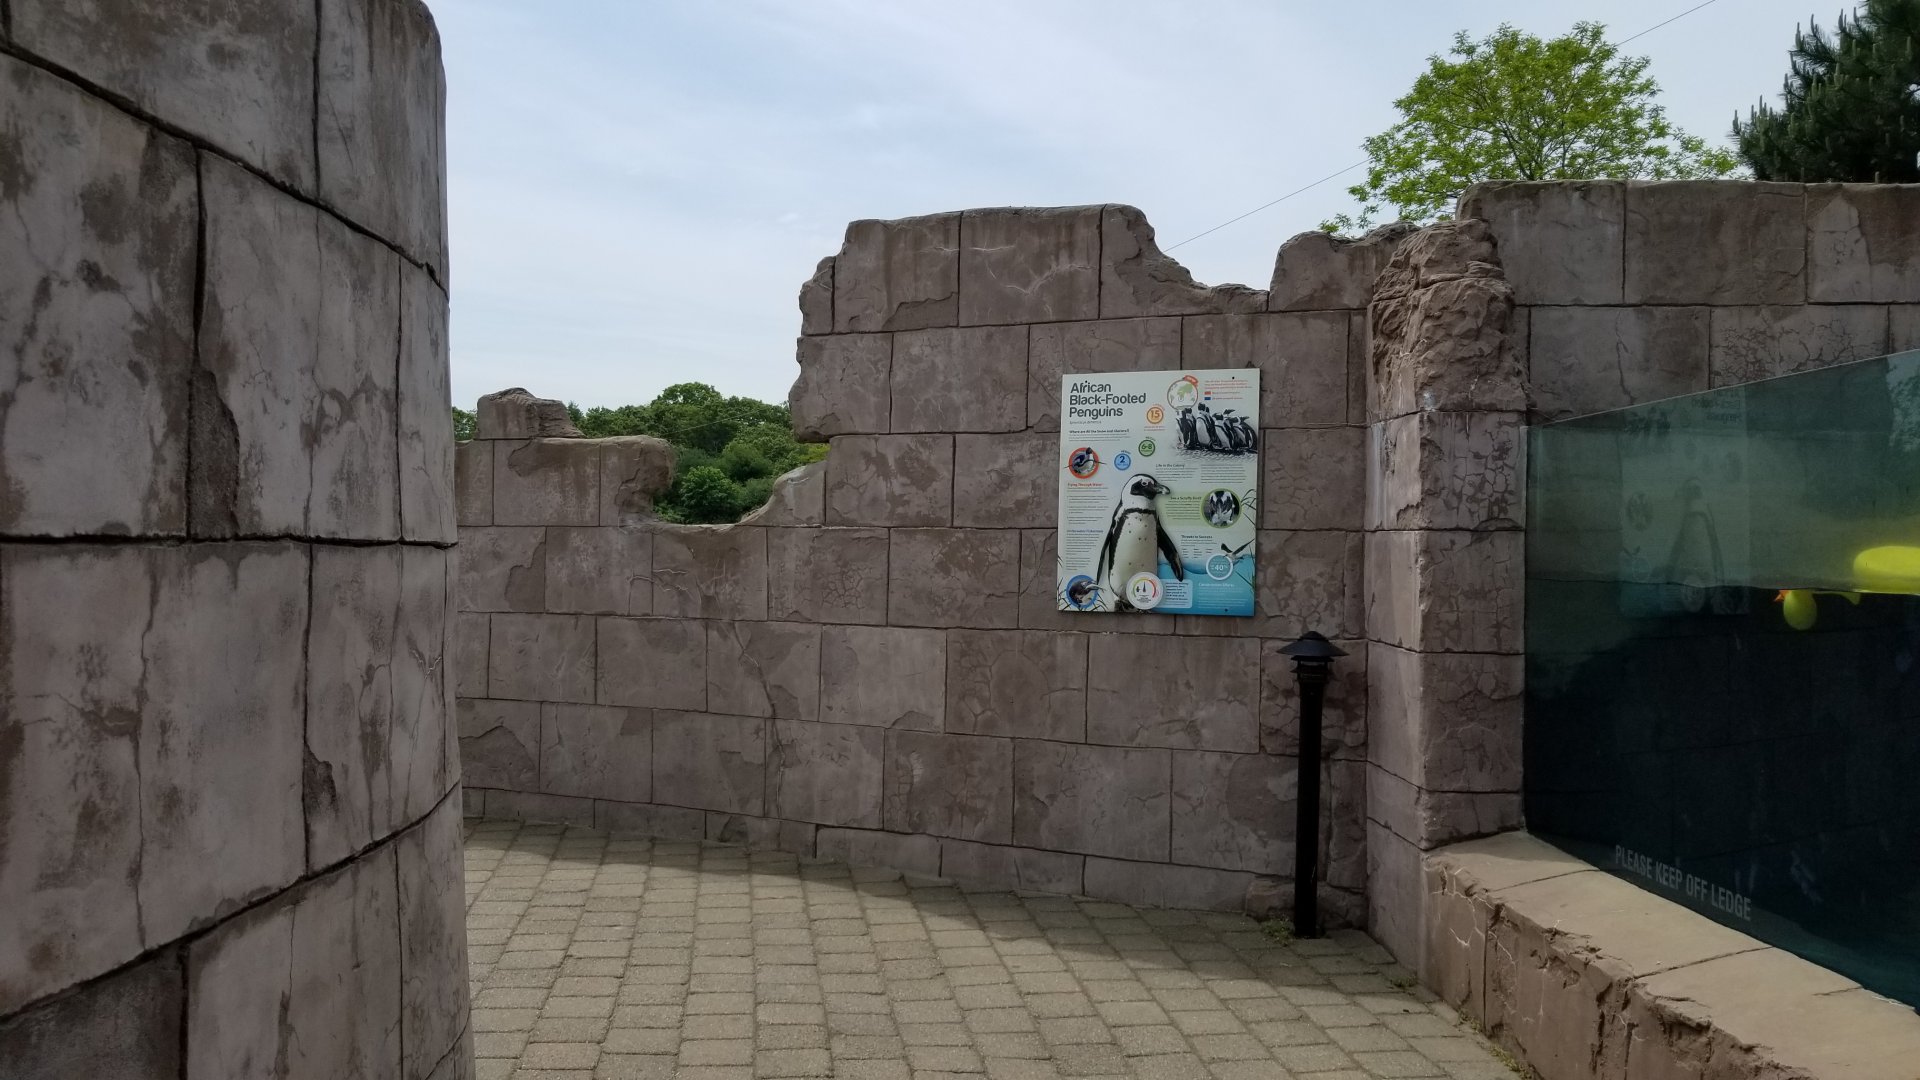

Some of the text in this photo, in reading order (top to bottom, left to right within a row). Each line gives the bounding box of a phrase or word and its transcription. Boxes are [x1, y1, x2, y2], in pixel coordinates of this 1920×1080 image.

[1070, 382, 1112, 394] African
[1069, 393, 1147, 406] Black-Footed
[1069, 406, 1124, 420] Penguins
[1150, 410, 1160, 419] 15
[1615, 844, 1752, 922] PLEASE KEEP OFF LEDGE
